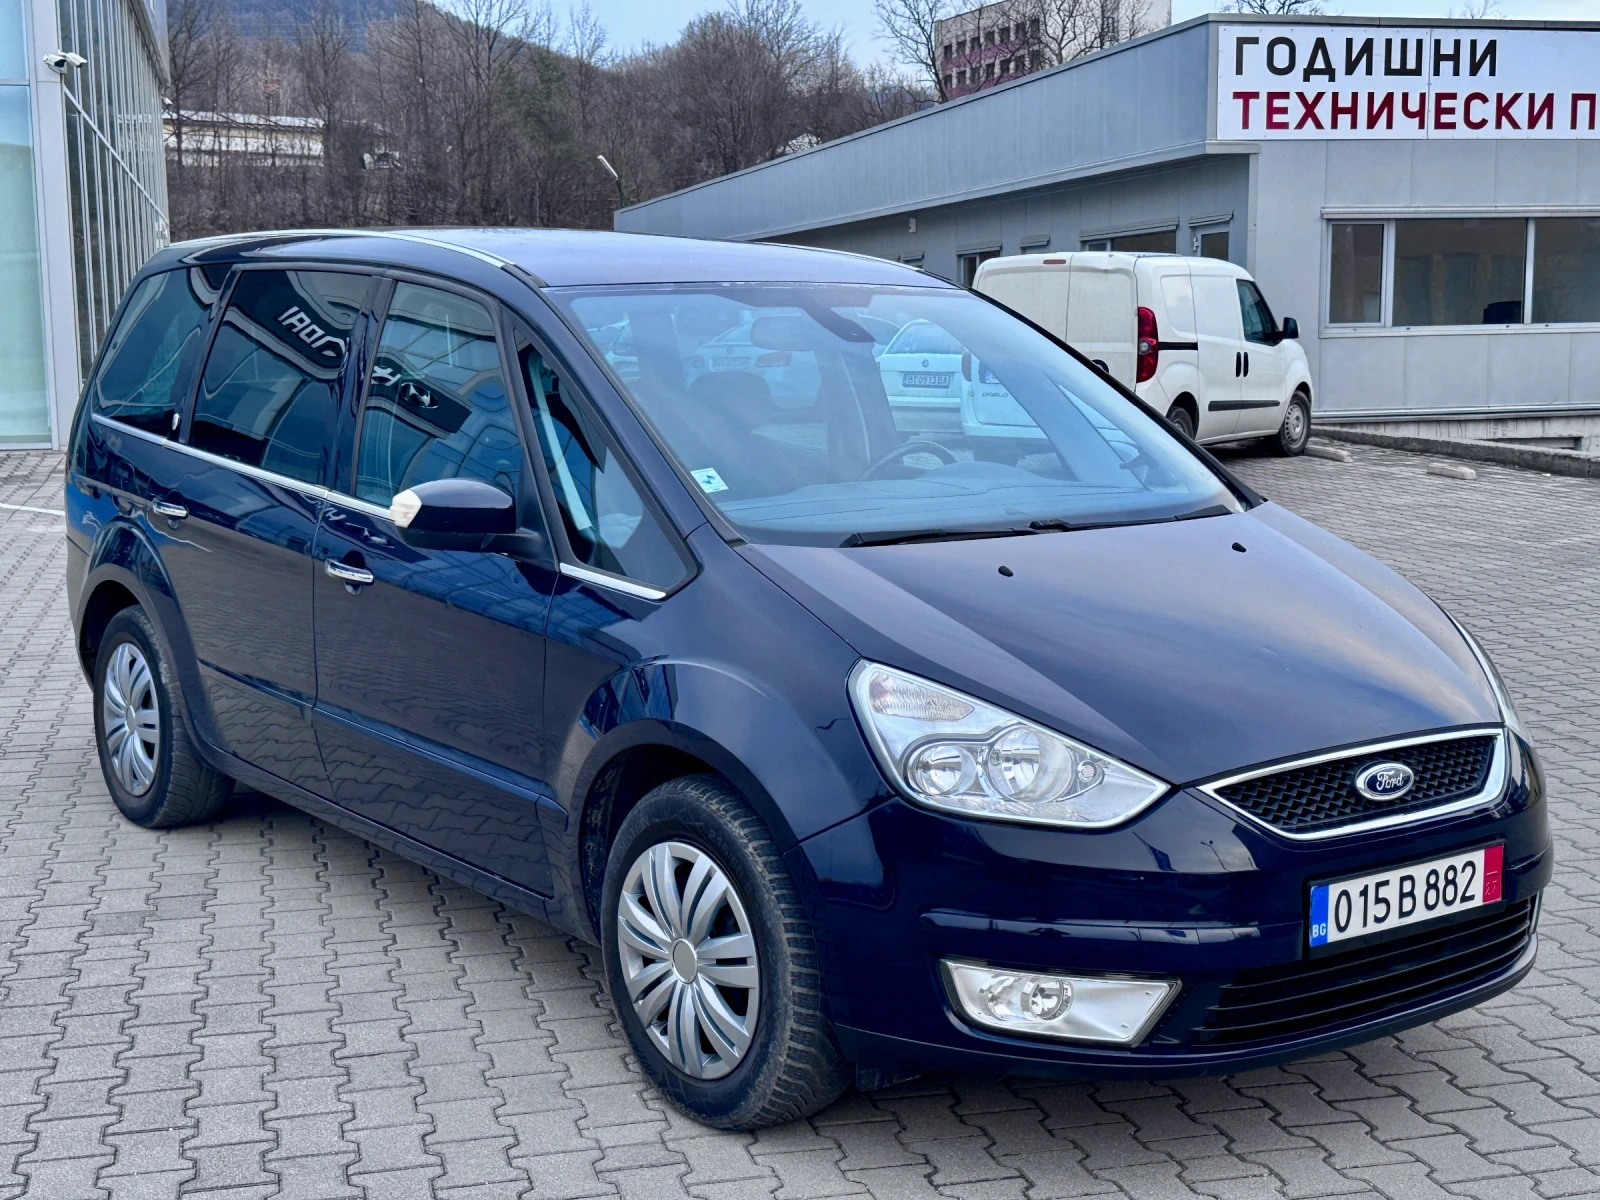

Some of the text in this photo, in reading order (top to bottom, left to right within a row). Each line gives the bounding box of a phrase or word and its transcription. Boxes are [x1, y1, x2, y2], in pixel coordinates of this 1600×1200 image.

[1235, 36, 1497, 82] ГОДИШНИ
[1232, 91, 1596, 130] ТЕХНИЧЕСКИ П
[1376, 769, 1404, 791] Ford
[1334, 860, 1477, 933] 015B882
[1312, 923, 1327, 938] BG
